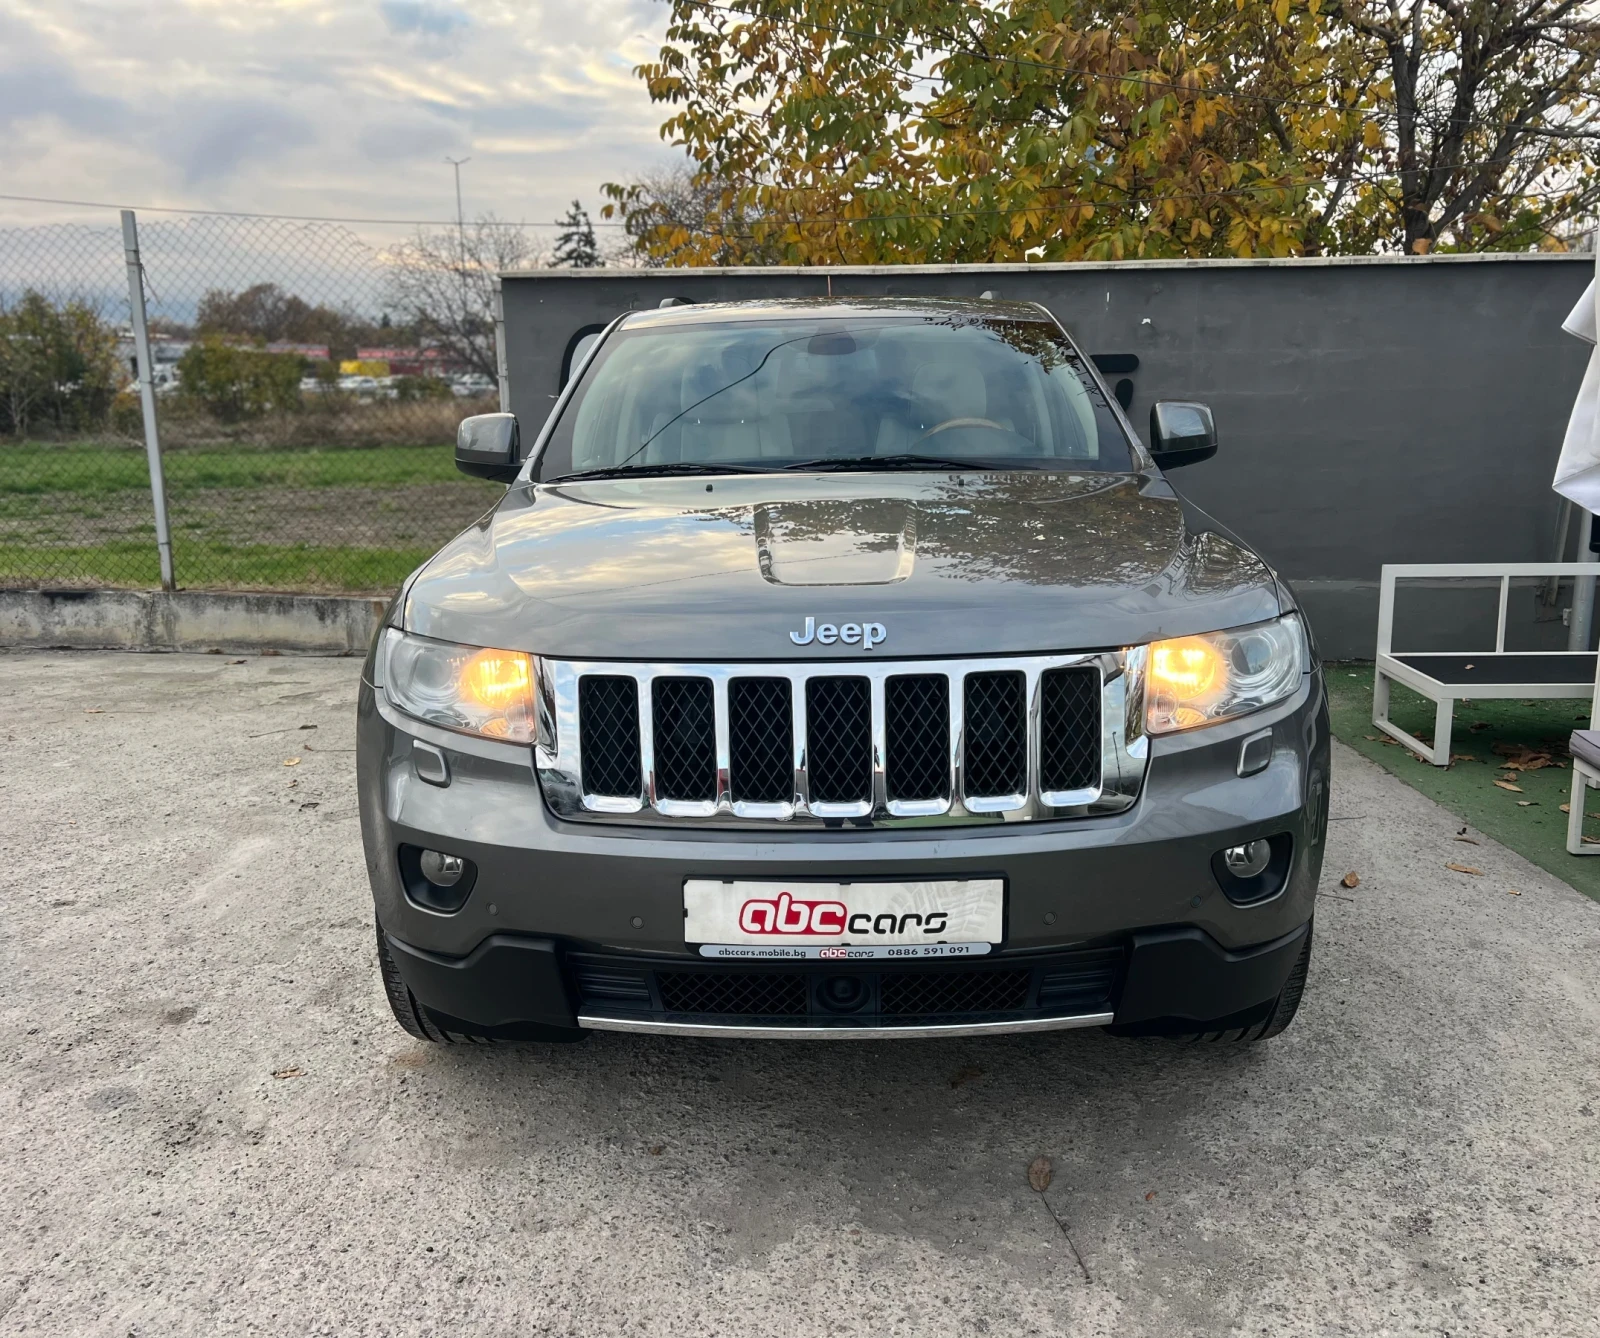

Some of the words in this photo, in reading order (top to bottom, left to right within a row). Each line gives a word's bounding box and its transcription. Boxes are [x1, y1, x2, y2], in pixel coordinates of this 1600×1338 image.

[789, 616, 887, 650] Jeep
[718, 948, 807, 958] abccars.mobile.bg
[888, 948, 918, 956] 0886
[923, 947, 943, 955] 591
[949, 946, 969, 954] 091
